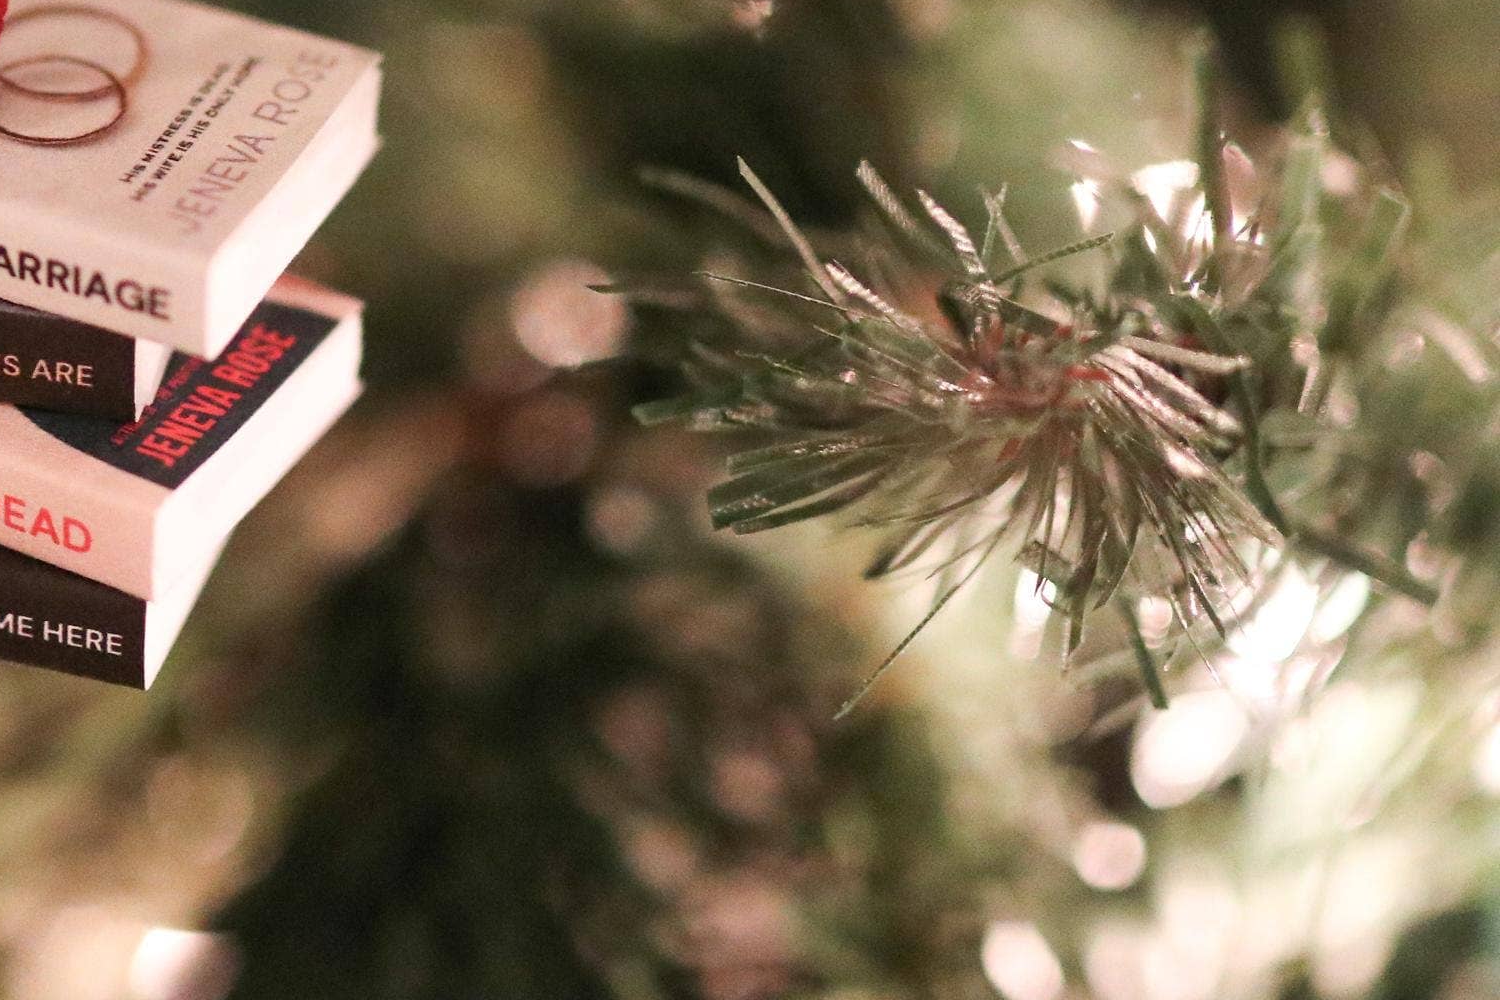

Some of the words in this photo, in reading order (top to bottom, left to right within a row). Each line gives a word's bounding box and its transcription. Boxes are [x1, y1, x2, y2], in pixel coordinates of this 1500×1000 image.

[119, 163, 147, 183] HIS
[140, 109, 193, 163] MISTRESS
[152, 152, 183, 180] WIFE
[175, 140, 194, 153] IS
[186, 119, 211, 139] HIS
[167, 134, 277, 236] JENEVA
[251, 49, 340, 127] ROSE
[30, 358, 95, 388] ARE
[136, 384, 243, 469] JENEVA
[210, 322, 297, 389] ROSE
[42, 619, 124, 657] HERE
